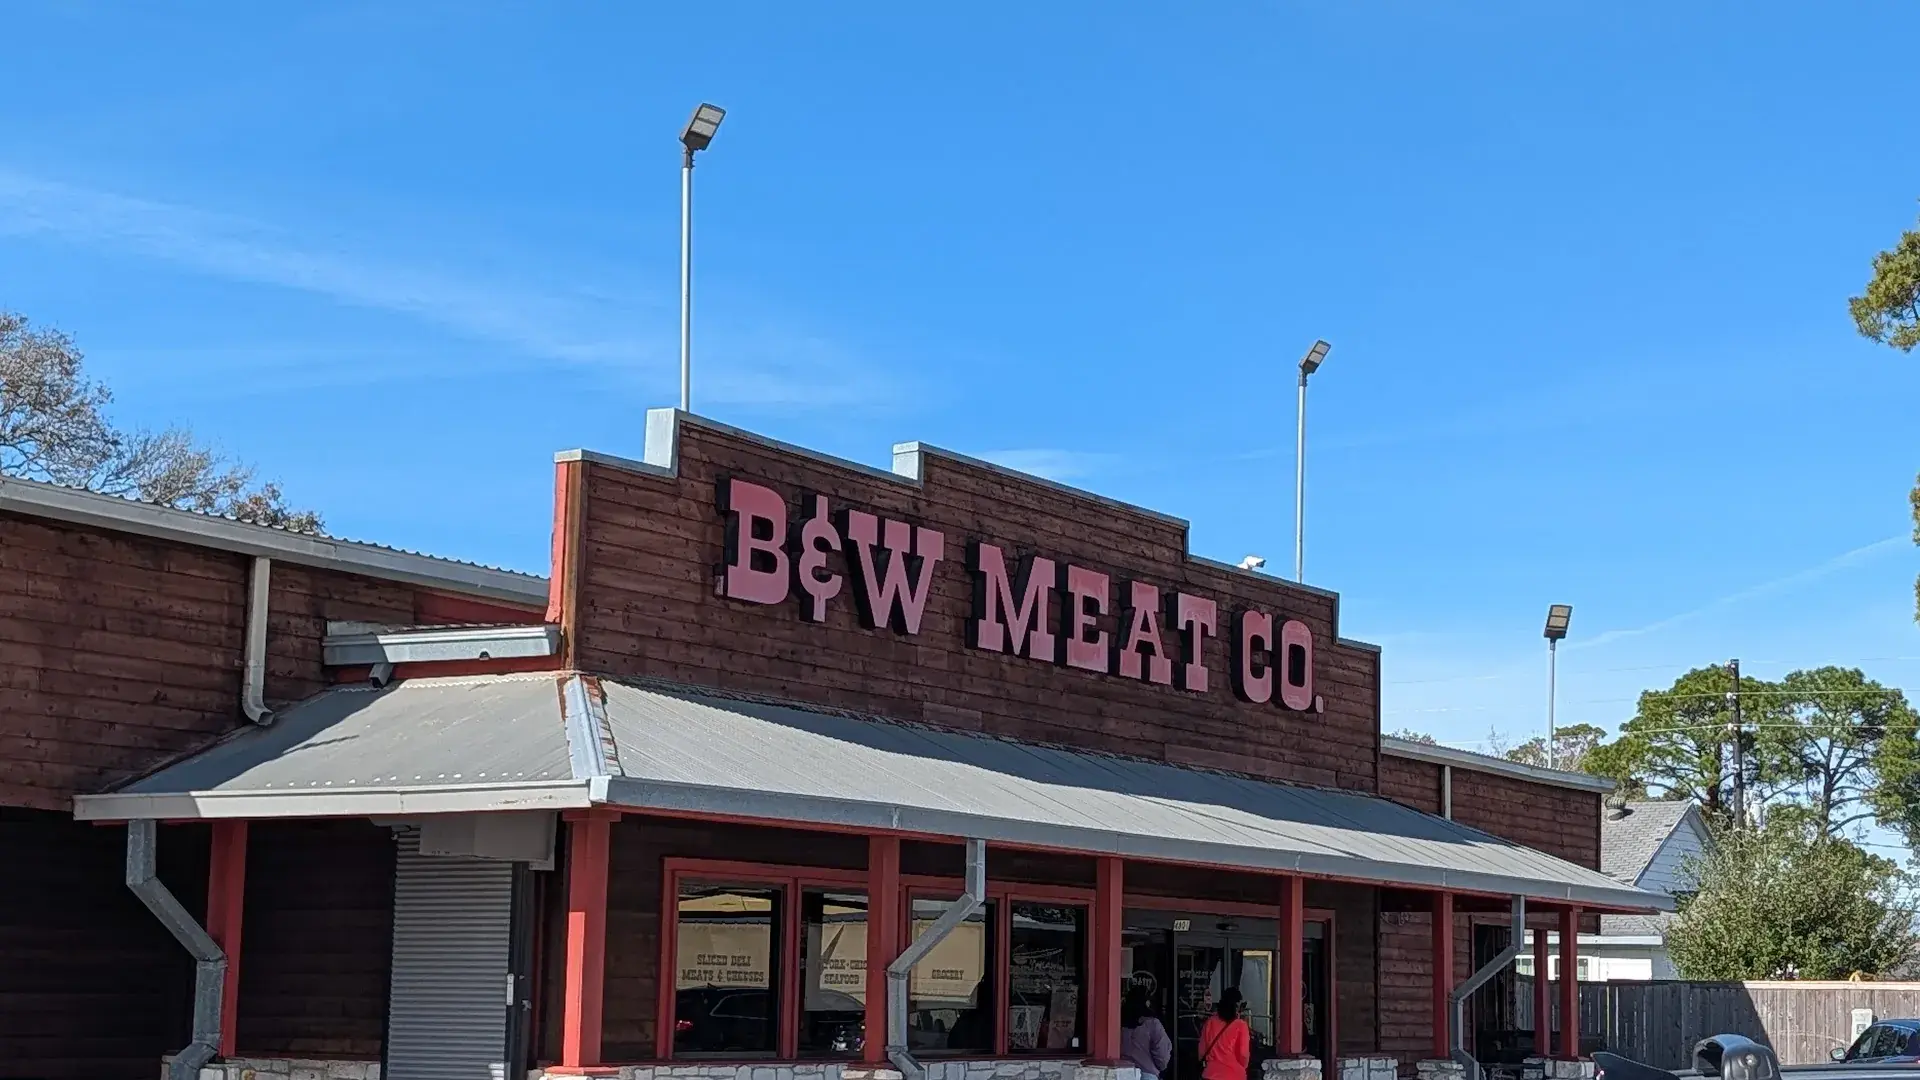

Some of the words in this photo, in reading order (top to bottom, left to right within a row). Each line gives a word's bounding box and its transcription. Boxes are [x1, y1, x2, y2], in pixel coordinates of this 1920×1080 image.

[727, 478, 945, 635] B&W
[978, 542, 1217, 692] MEAT
[1242, 609, 1324, 714] CO.
[697, 954, 727, 966] SLICED
[731, 955, 752, 967] DELI
[682, 969, 714, 981] MEATS
[726, 970, 764, 982] CHEESES
[824, 973, 859, 985] SEAFOOD
[932, 969, 964, 980] GROCERY
